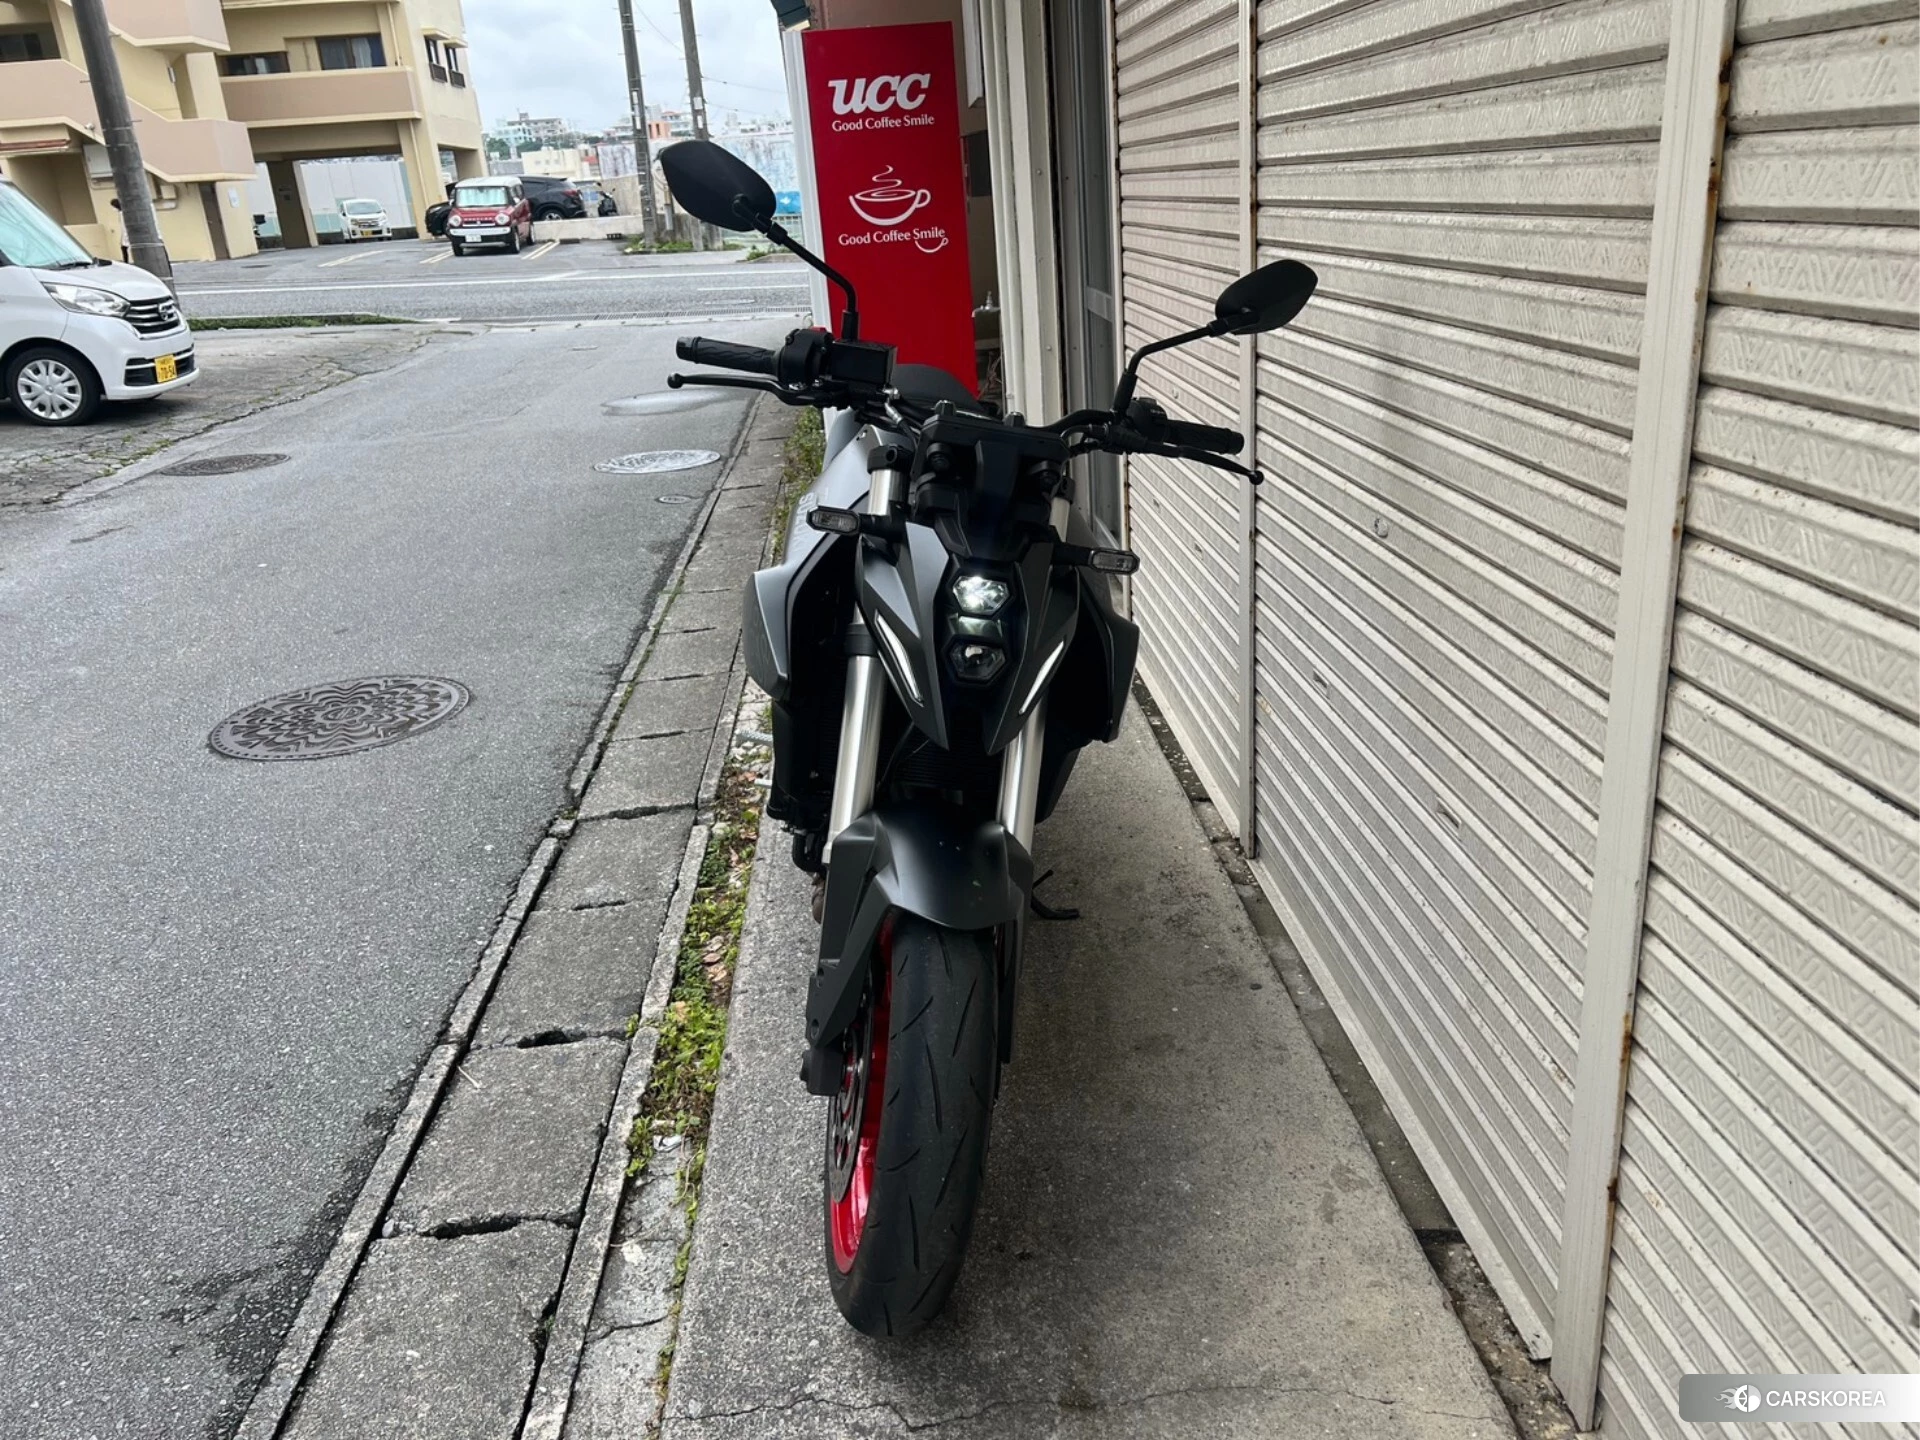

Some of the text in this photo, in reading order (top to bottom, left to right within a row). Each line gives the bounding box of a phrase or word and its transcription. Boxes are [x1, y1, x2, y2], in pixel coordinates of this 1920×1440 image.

[832, 114, 935, 132] Good Coffee Smile
[838, 226, 945, 246] Good Coffee Smile
